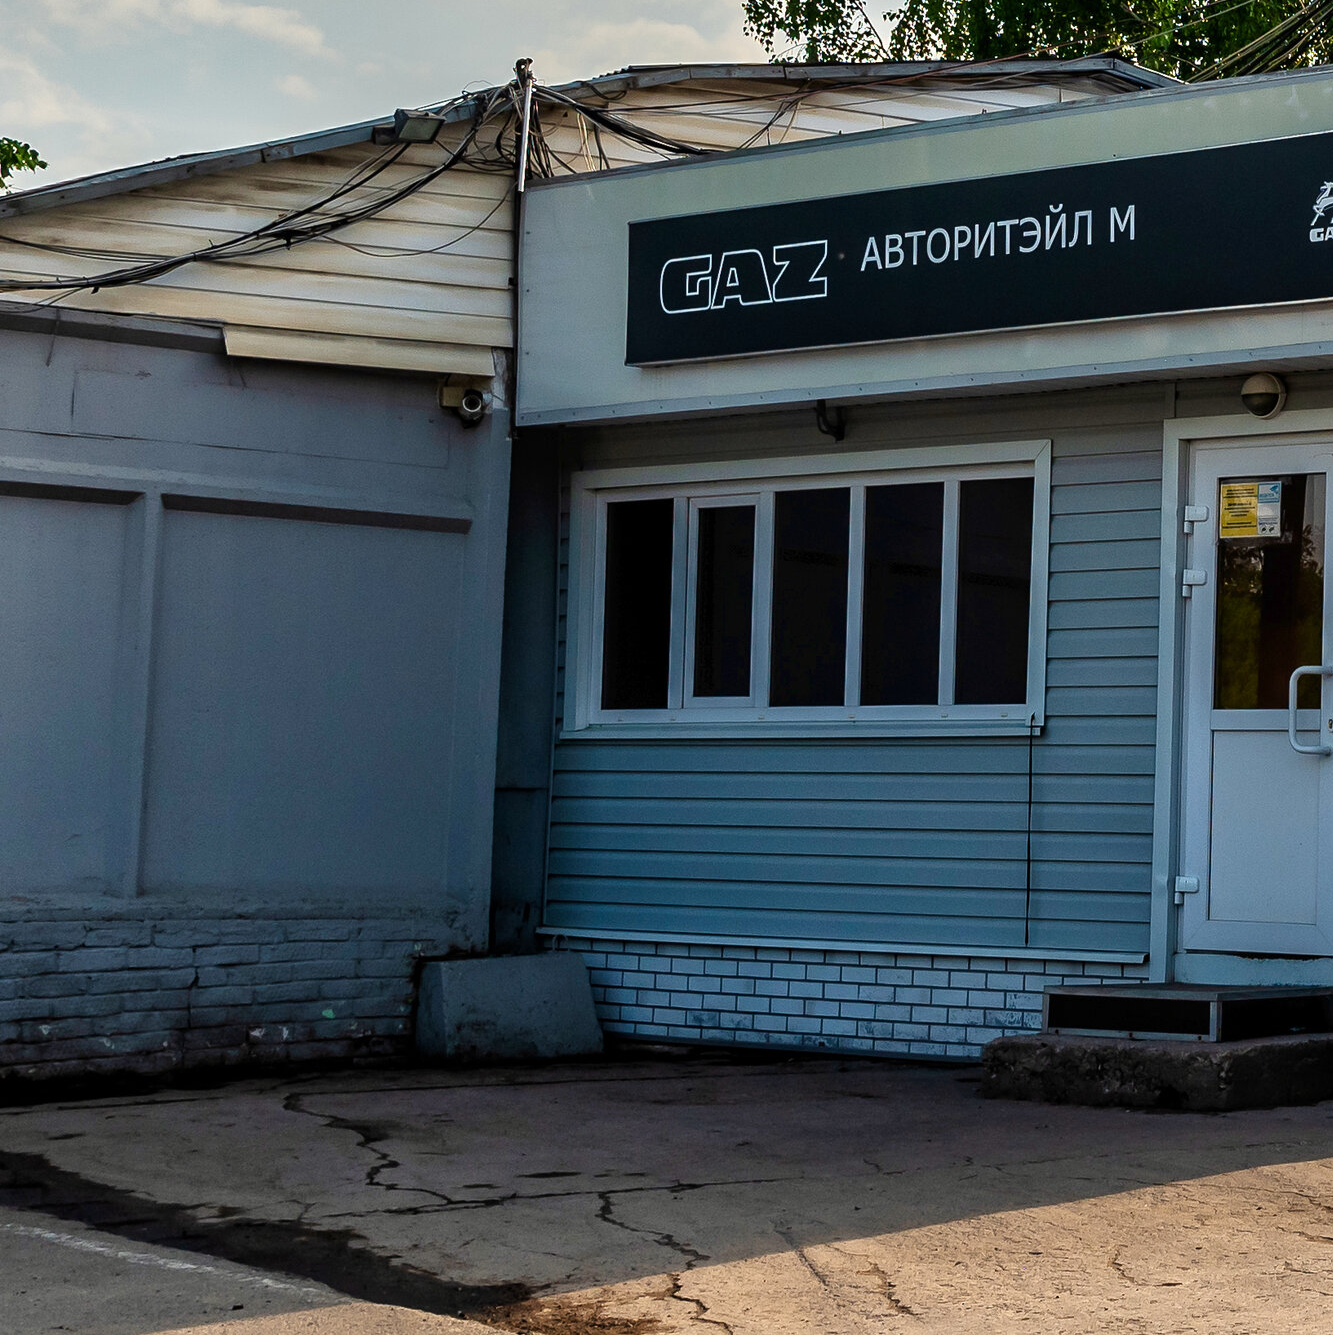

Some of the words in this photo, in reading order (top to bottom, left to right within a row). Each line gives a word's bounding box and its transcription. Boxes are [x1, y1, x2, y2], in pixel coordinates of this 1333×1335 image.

[860, 203, 1093, 272] АВТОРИТЭЙЛ
[1109, 204, 1136, 244] М
[659, 239, 828, 314] GAZ
